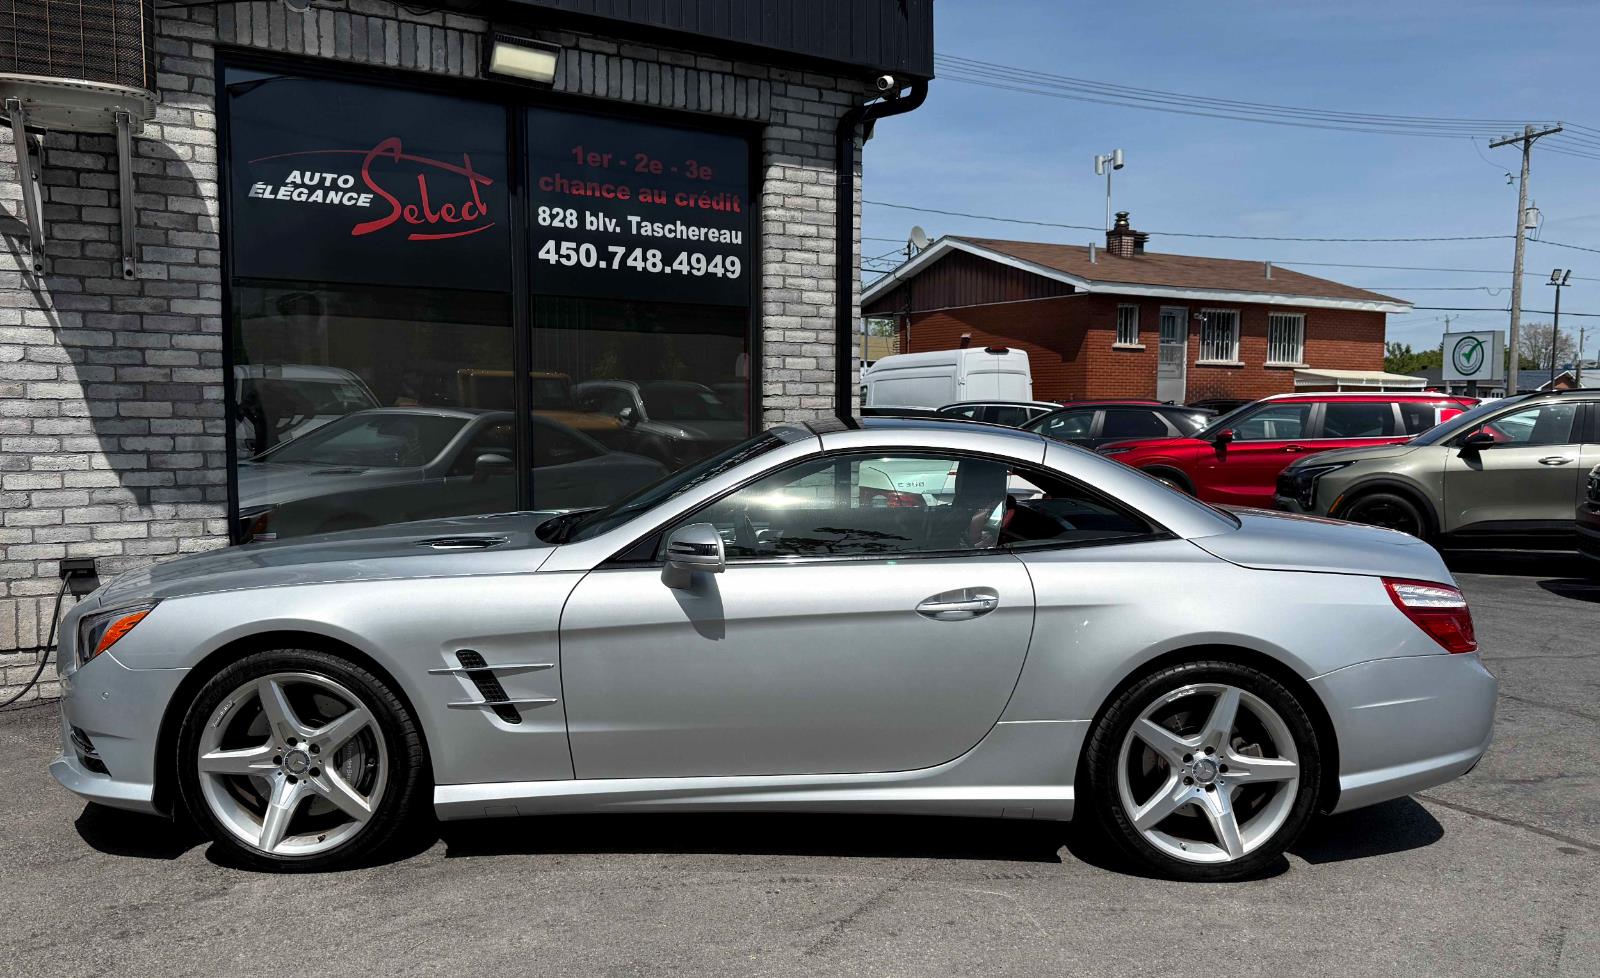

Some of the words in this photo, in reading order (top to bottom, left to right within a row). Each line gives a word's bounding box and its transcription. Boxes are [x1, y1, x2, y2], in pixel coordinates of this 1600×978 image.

[285, 170, 355, 189] AUTO
[571, 145, 612, 168] 1er
[634, 152, 664, 175] 2e
[685, 159, 713, 180] 3e
[248, 181, 374, 207] ÉLÉGANCE
[351, 136, 494, 236] Select
[538, 172, 631, 200] chance
[639, 187, 667, 205] au
[674, 189, 741, 213] crédit
[537, 206, 578, 229] 828
[585, 210, 621, 233] blv.
[627, 215, 742, 245] Taschereau
[538, 239, 742, 279] 450.748.4949
